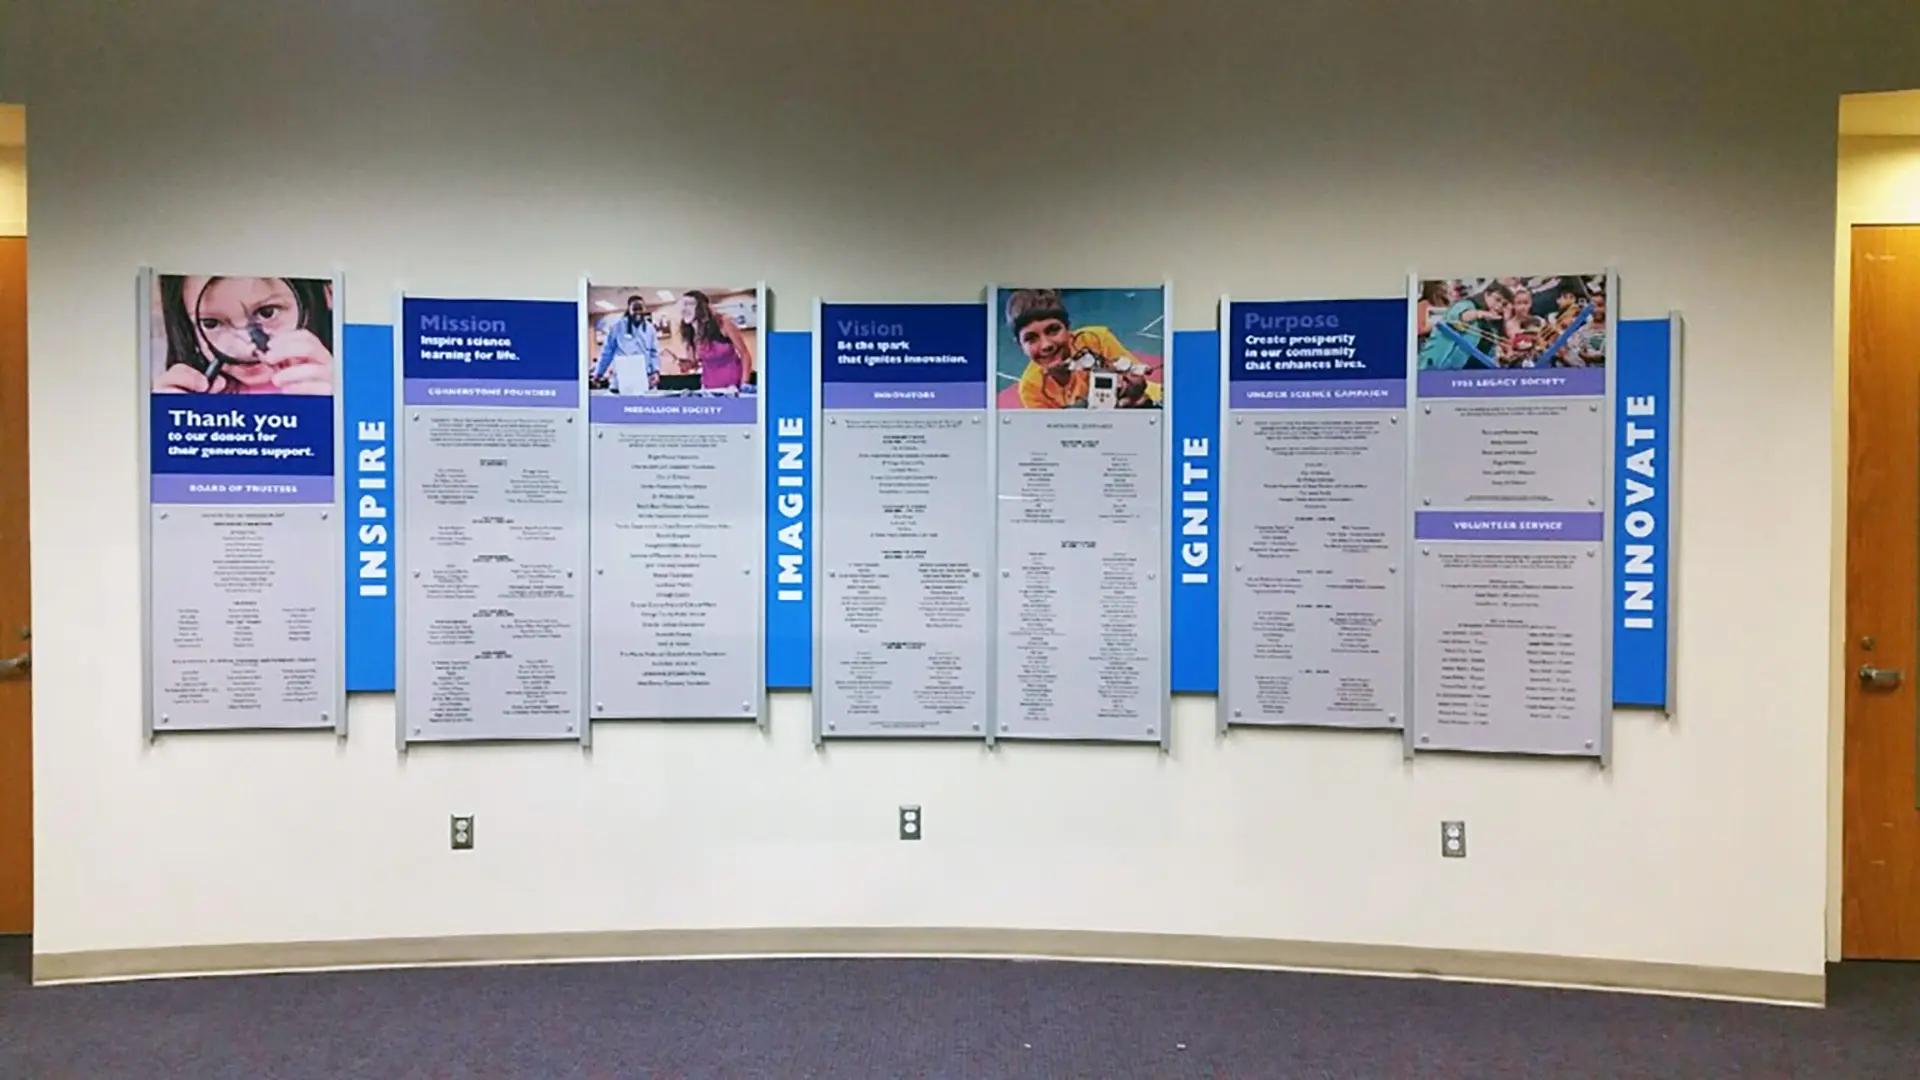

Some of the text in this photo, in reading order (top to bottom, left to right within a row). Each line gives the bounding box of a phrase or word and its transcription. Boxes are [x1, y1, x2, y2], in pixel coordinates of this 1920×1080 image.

[421, 315, 505, 332] Mission
[1245, 312, 1340, 327] Purpose
[838, 320, 903, 336] Vision
[421, 335, 512, 348] Inspire science
[838, 341, 909, 352] Be the spark
[1246, 334, 1356, 347] Create prosperity
[421, 350, 519, 362] learning for life.
[1245, 347, 1356, 359] in our community
[838, 354, 967, 367] that ignites innovation.
[1245, 359, 1366, 370] that enhances lives.
[1476, 378, 1518, 387] LEGACY
[1520, 377, 1566, 386] SOCIETY
[427, 387, 557, 397] CORNERSTONE FOUNDERS
[1246, 389, 1389, 399] UNLOCK SCIENCE CAMPAIGN
[623, 406, 722, 415] MEDALLION SOCIETY
[169, 409, 297, 432] Thank you
[168, 431, 278, 442] to our donors for
[168, 446, 314, 458] their generous support.
[189, 484, 298, 493] BOARD OF TRUSTEES
[359, 422, 387, 596] INSPIRE
[778, 418, 803, 600] IMAGINE
[1182, 438, 1208, 583] IGNITE
[1624, 396, 1654, 628] INNOVATE
[1453, 521, 1563, 530] VOLUNTEER SERVICE
